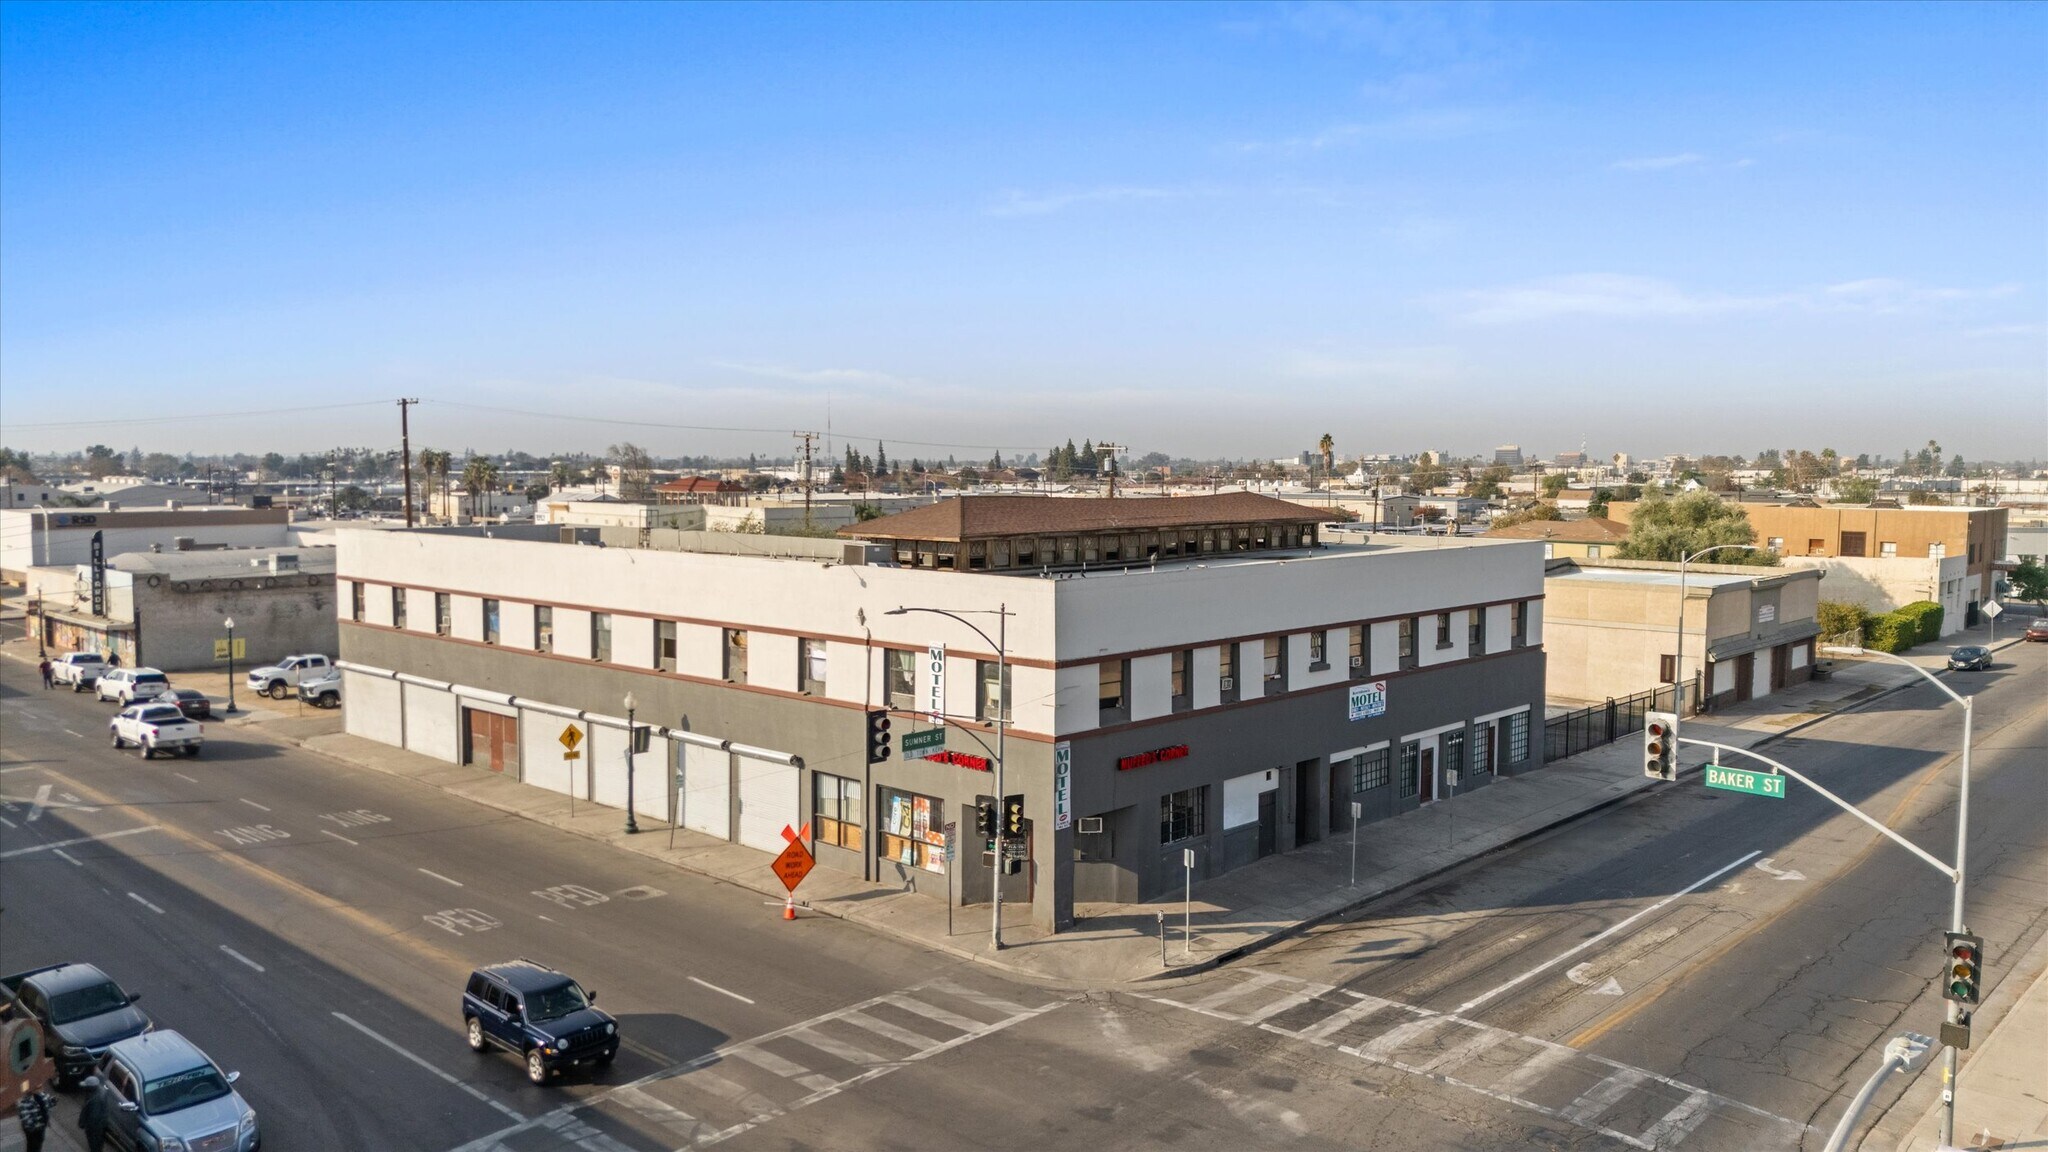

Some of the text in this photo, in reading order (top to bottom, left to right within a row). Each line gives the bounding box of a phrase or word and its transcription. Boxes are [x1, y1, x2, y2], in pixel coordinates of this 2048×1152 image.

[72, 515, 97, 524] RSD
[93, 541, 102, 611] BILLIARDS
[930, 649, 942, 711] MOTEL
[1352, 692, 1382, 707] MOTEL
[904, 732, 943, 747] SUMNER ST
[953, 751, 988, 772] CORNER
[1160, 744, 1189, 761] CORNER
[1056, 749, 1069, 815] MOTEL
[1709, 769, 1782, 793] BAKER ST
[318, 809, 392, 828] XING
[213, 824, 291, 845] XING
[785, 861, 803, 869] WORK
[530, 884, 610, 910] PED
[423, 908, 503, 936] PED
